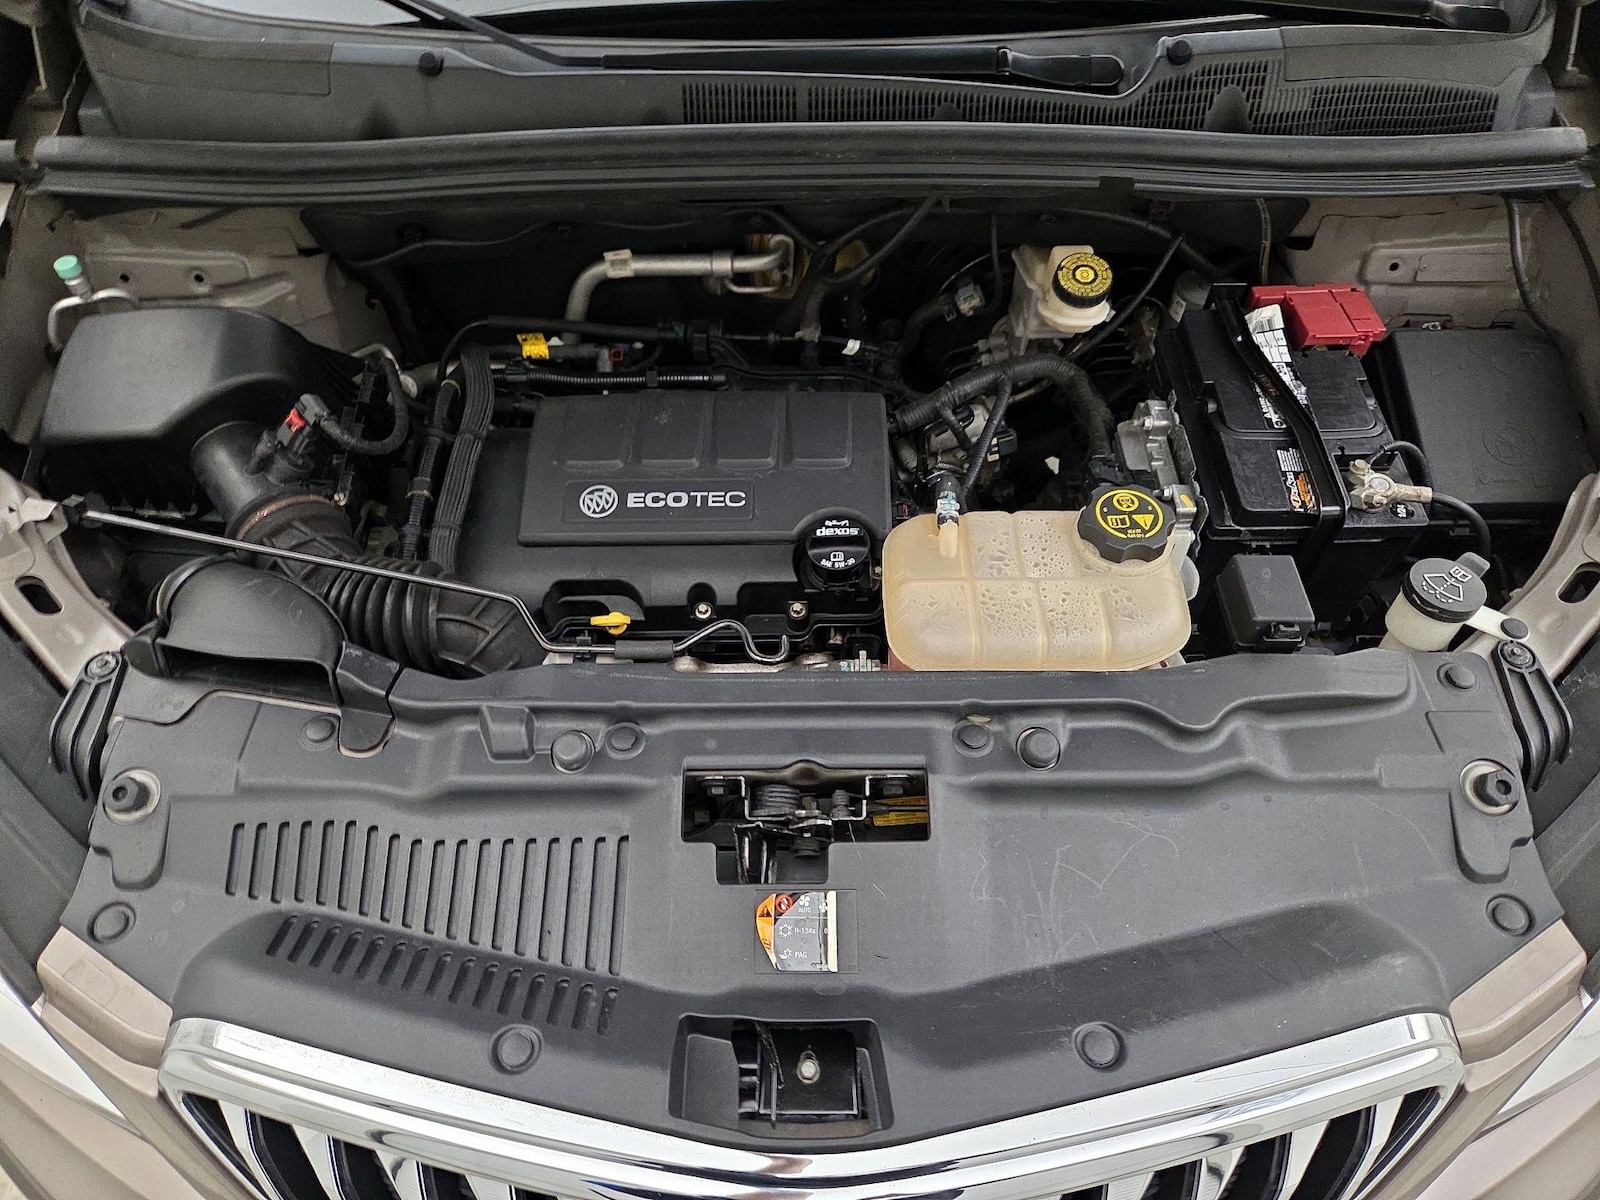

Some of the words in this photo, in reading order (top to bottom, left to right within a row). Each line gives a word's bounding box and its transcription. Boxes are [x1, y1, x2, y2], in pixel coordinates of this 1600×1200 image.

[627, 491, 746, 507] ECOTEC
[816, 526, 859, 536] dexos
[820, 558, 833, 568] SAE
[834, 557, 856, 568] 5W-30
[794, 951, 808, 959] PAG
